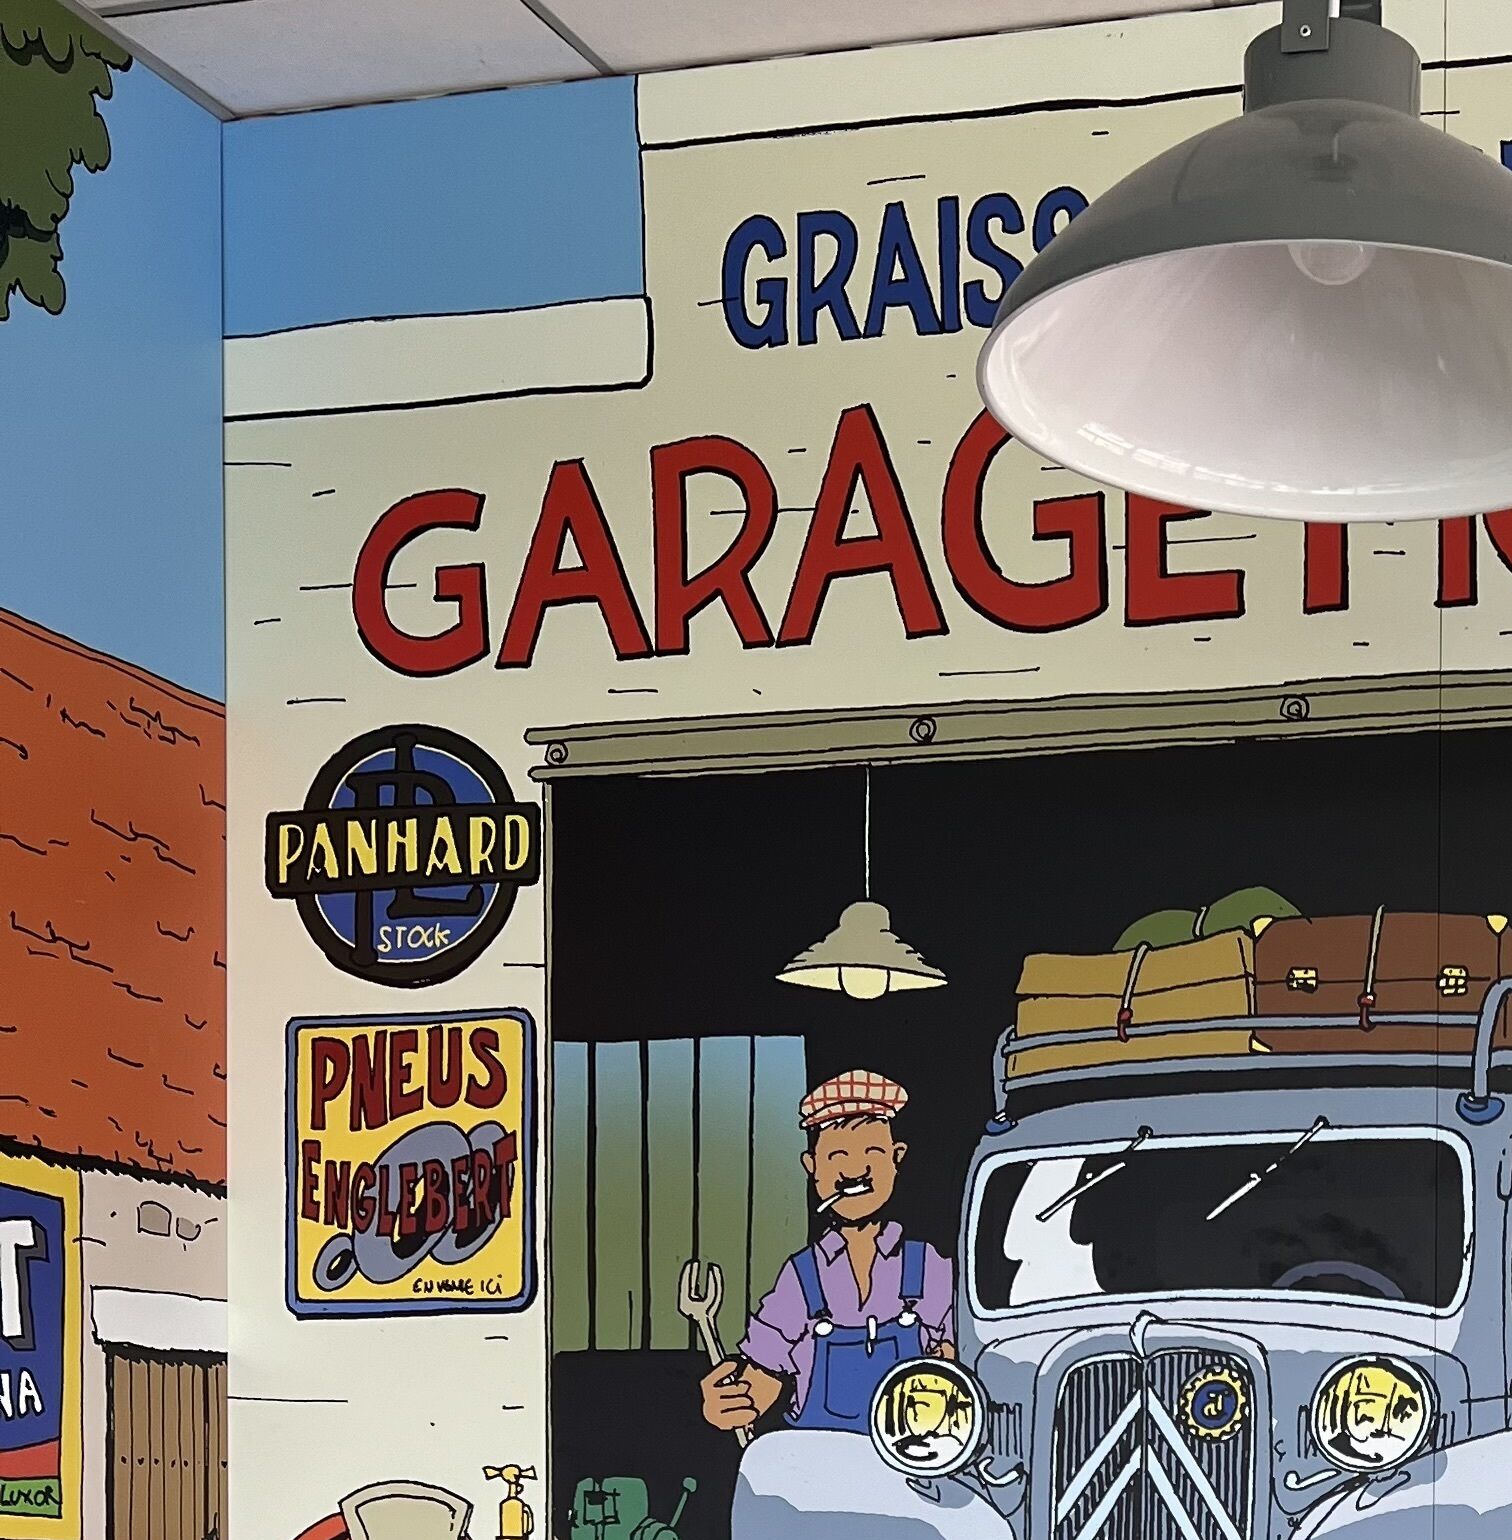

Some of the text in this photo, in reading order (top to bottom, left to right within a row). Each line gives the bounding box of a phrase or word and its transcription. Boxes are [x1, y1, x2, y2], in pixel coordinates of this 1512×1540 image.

[278, 814, 530, 884] PANHARD
[377, 922, 451, 952] STOCK
[310, 1024, 508, 1132] PNEUS
[300, 1130, 519, 1239] ENGLEBERT
[412, 1277, 434, 1294] EN
